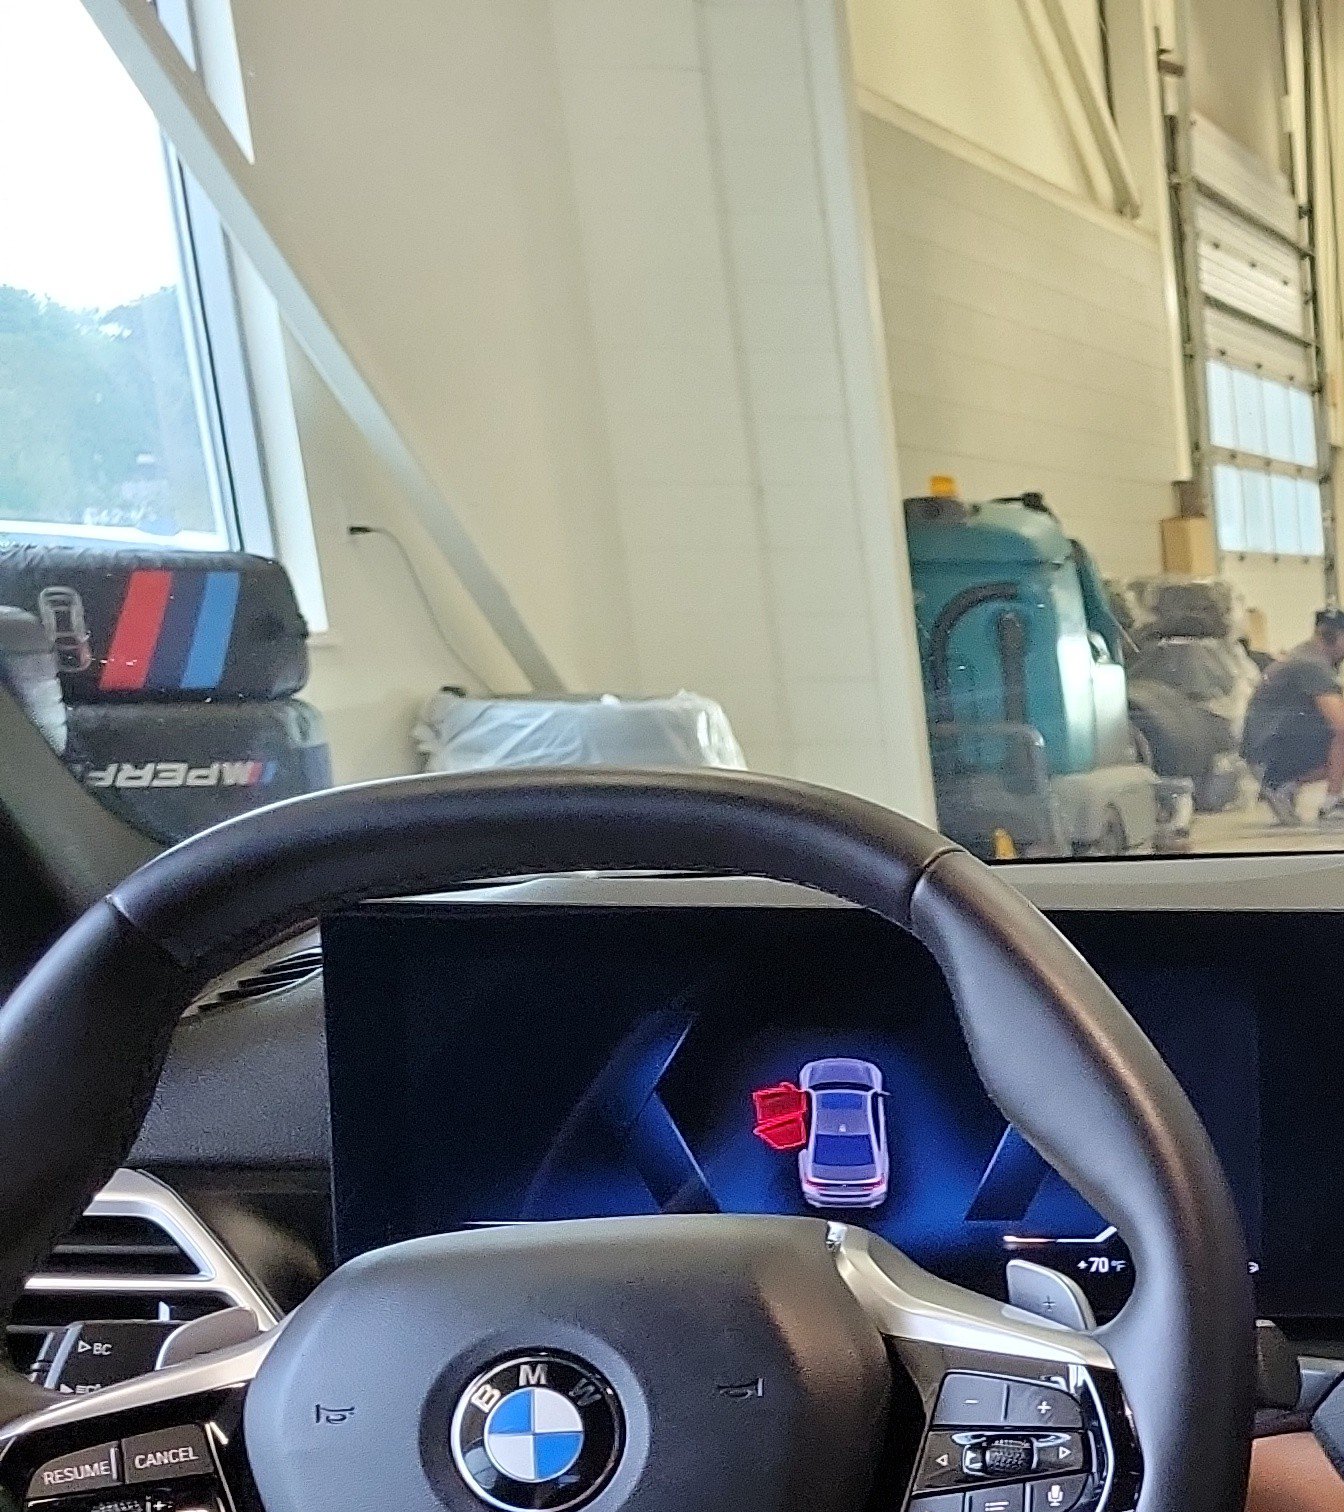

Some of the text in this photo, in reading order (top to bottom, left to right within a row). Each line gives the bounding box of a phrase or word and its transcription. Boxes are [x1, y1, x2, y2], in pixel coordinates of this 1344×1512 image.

[92, 1342, 112, 1356] BC
[471, 1363, 602, 1414] BMW
[134, 1446, 199, 1470] CANCEL
[43, 1460, 111, 1485] RESUME
